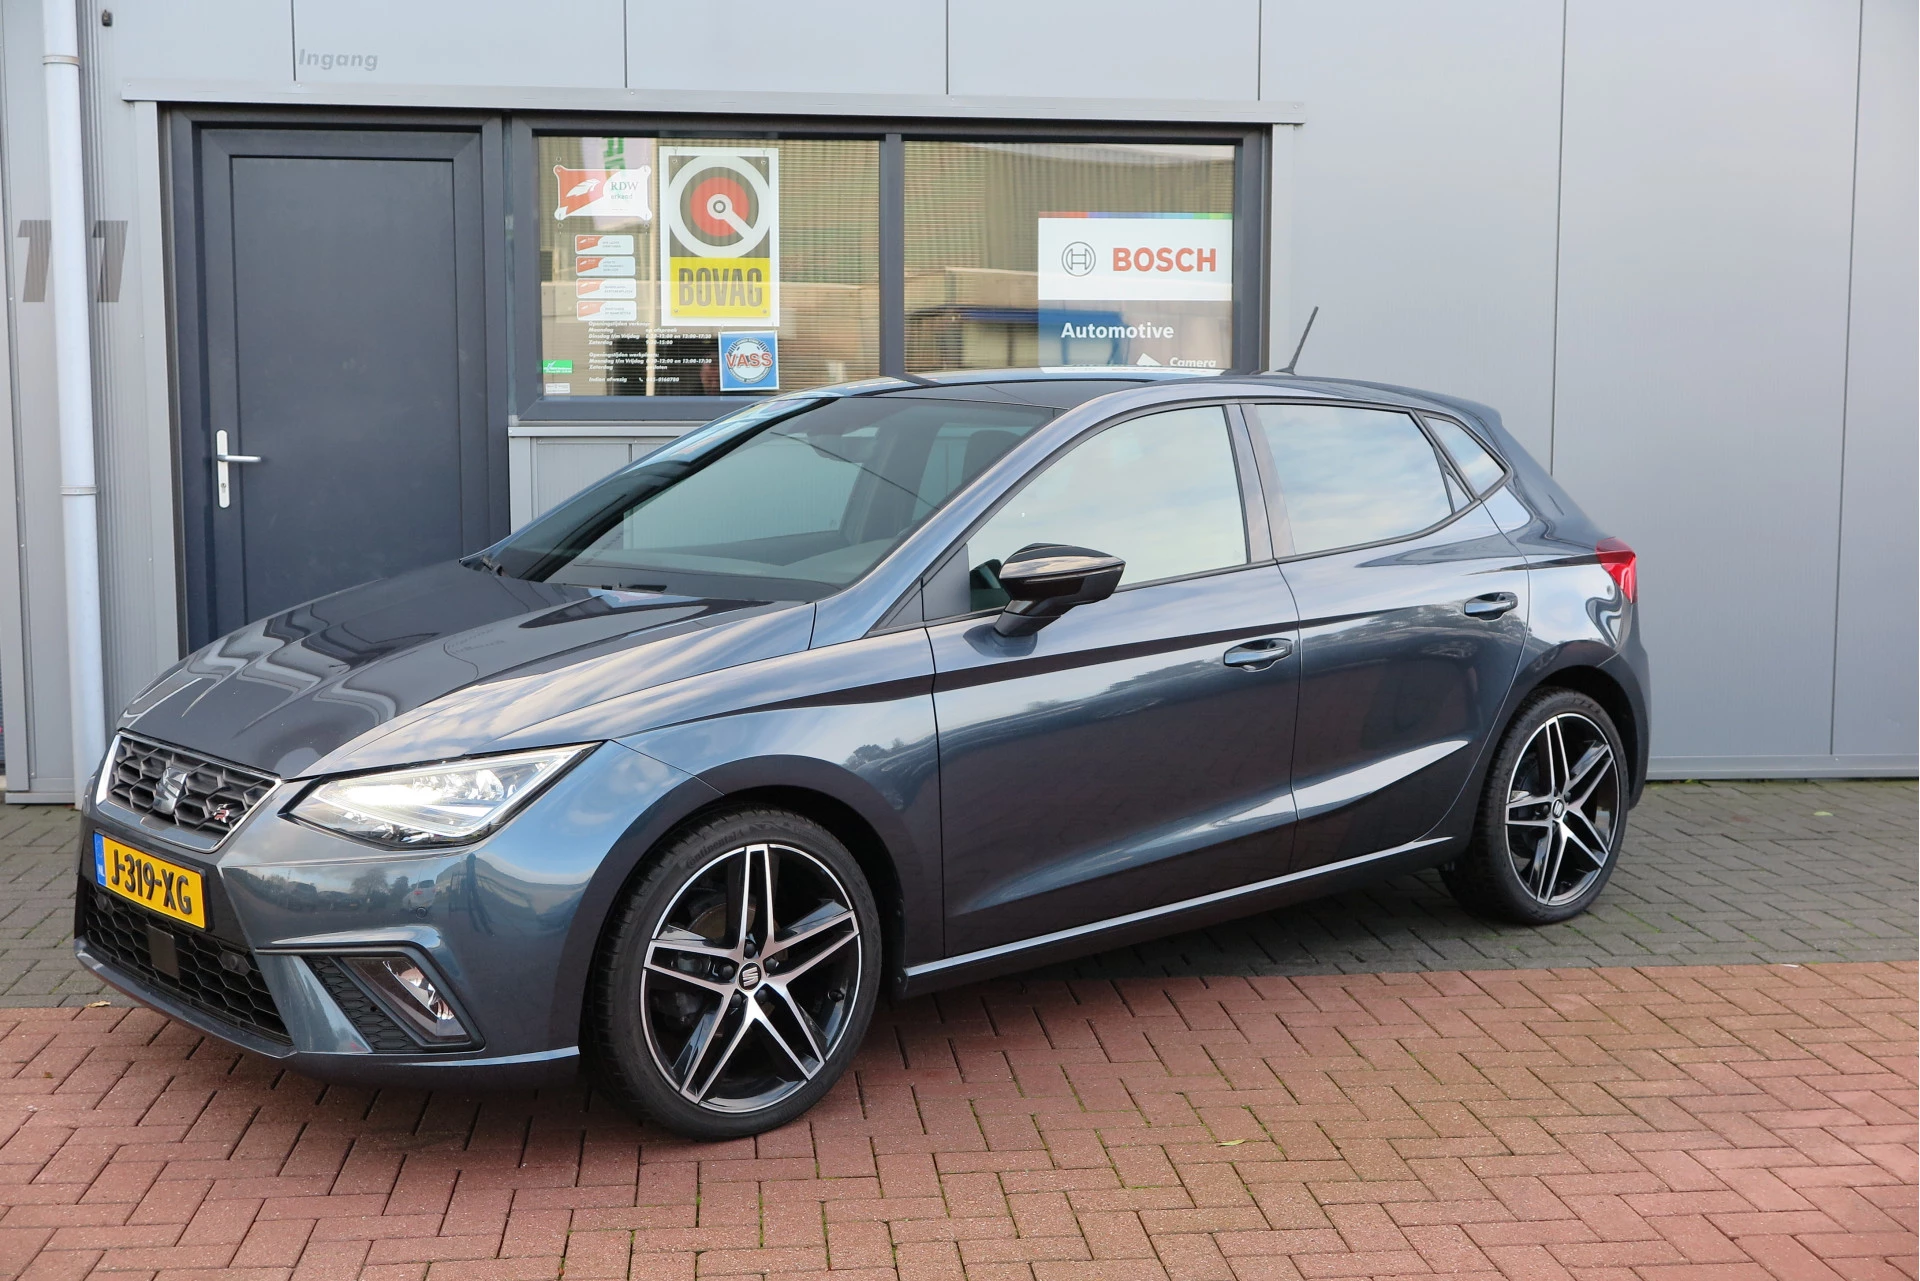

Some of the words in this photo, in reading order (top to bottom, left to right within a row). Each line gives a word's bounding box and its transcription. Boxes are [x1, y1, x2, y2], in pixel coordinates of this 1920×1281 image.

[299, 48, 378, 71] Ingang
[610, 181, 639, 191] RDW
[1112, 247, 1217, 273] BOSCH
[678, 267, 763, 307] BOVAG
[1061, 322, 1175, 339] Automotive
[725, 353, 773, 367] VASS
[1170, 357, 1217, 368] Camera
[111, 848, 193, 916] J-319-XG
